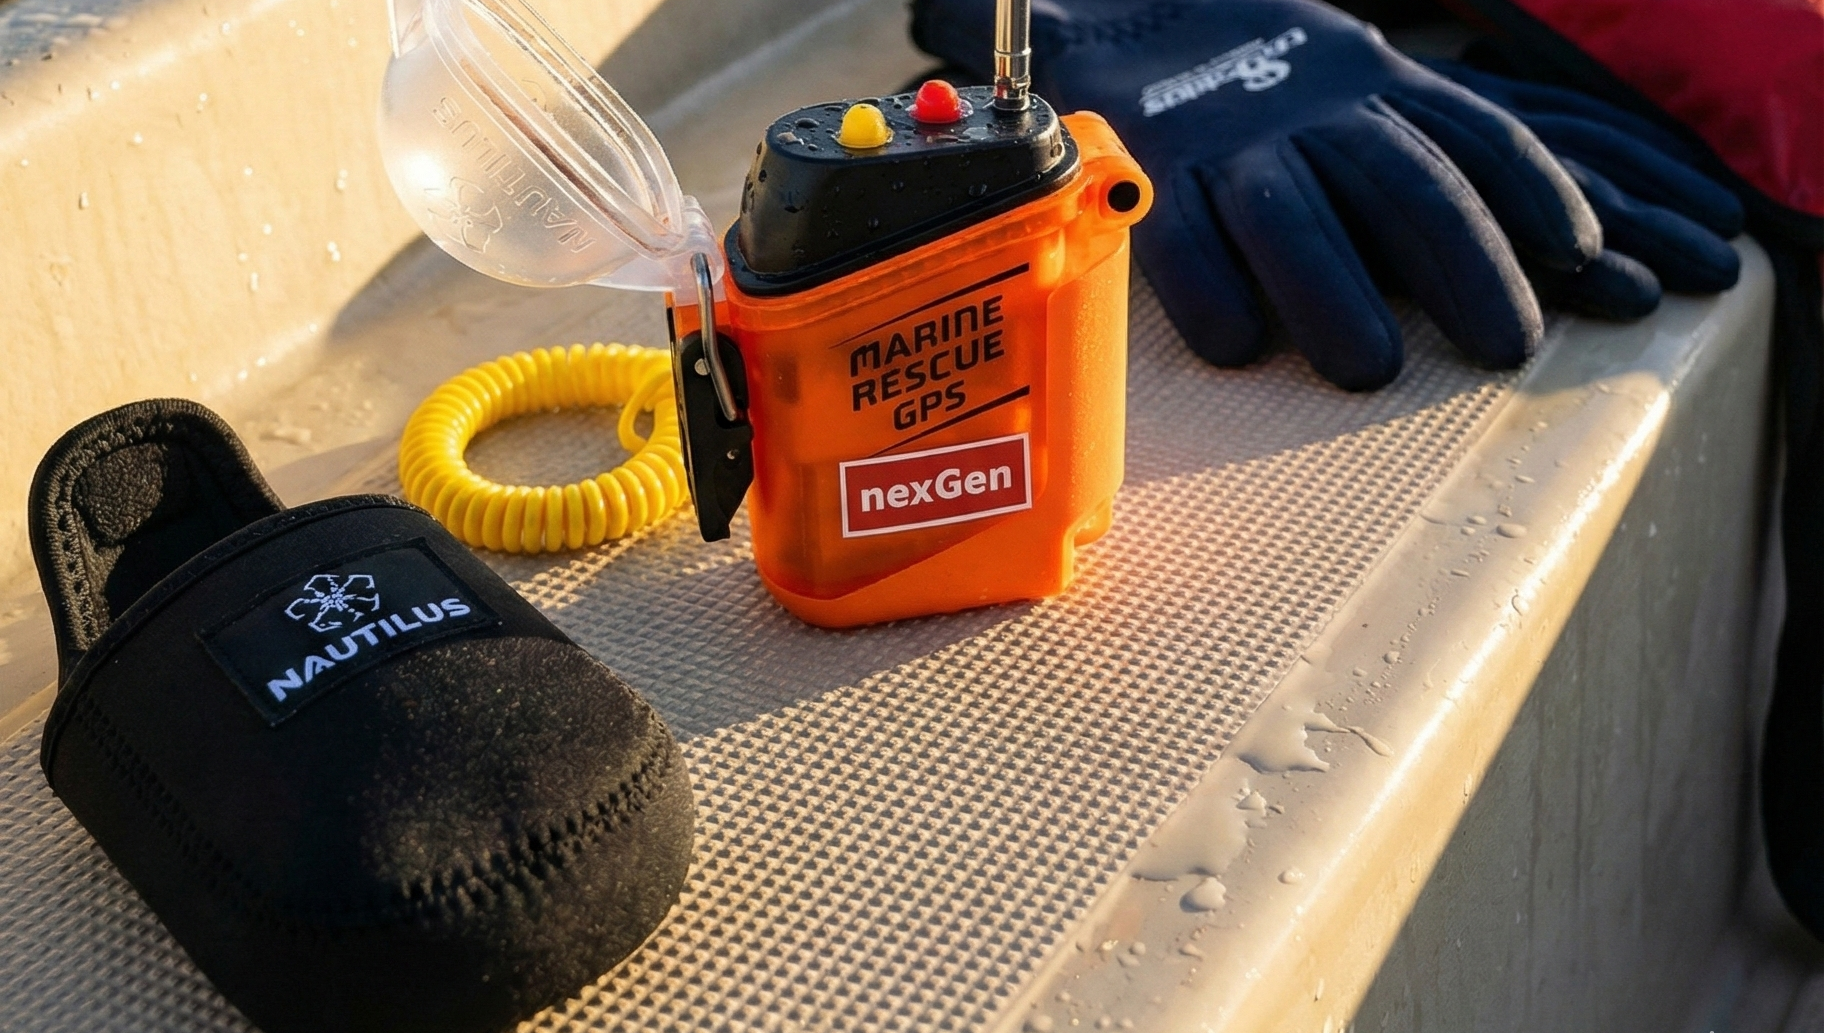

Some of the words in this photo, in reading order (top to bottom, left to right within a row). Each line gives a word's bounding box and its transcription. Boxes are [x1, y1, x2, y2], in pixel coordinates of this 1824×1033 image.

[432, 96, 597, 253] NAUTILUS
[850, 295, 1004, 377] MARINE
[852, 329, 1005, 412] RESCUE
[893, 380, 966, 431] GPS
[861, 464, 1012, 512] nexGen
[267, 597, 471, 702] NAUTILUS
